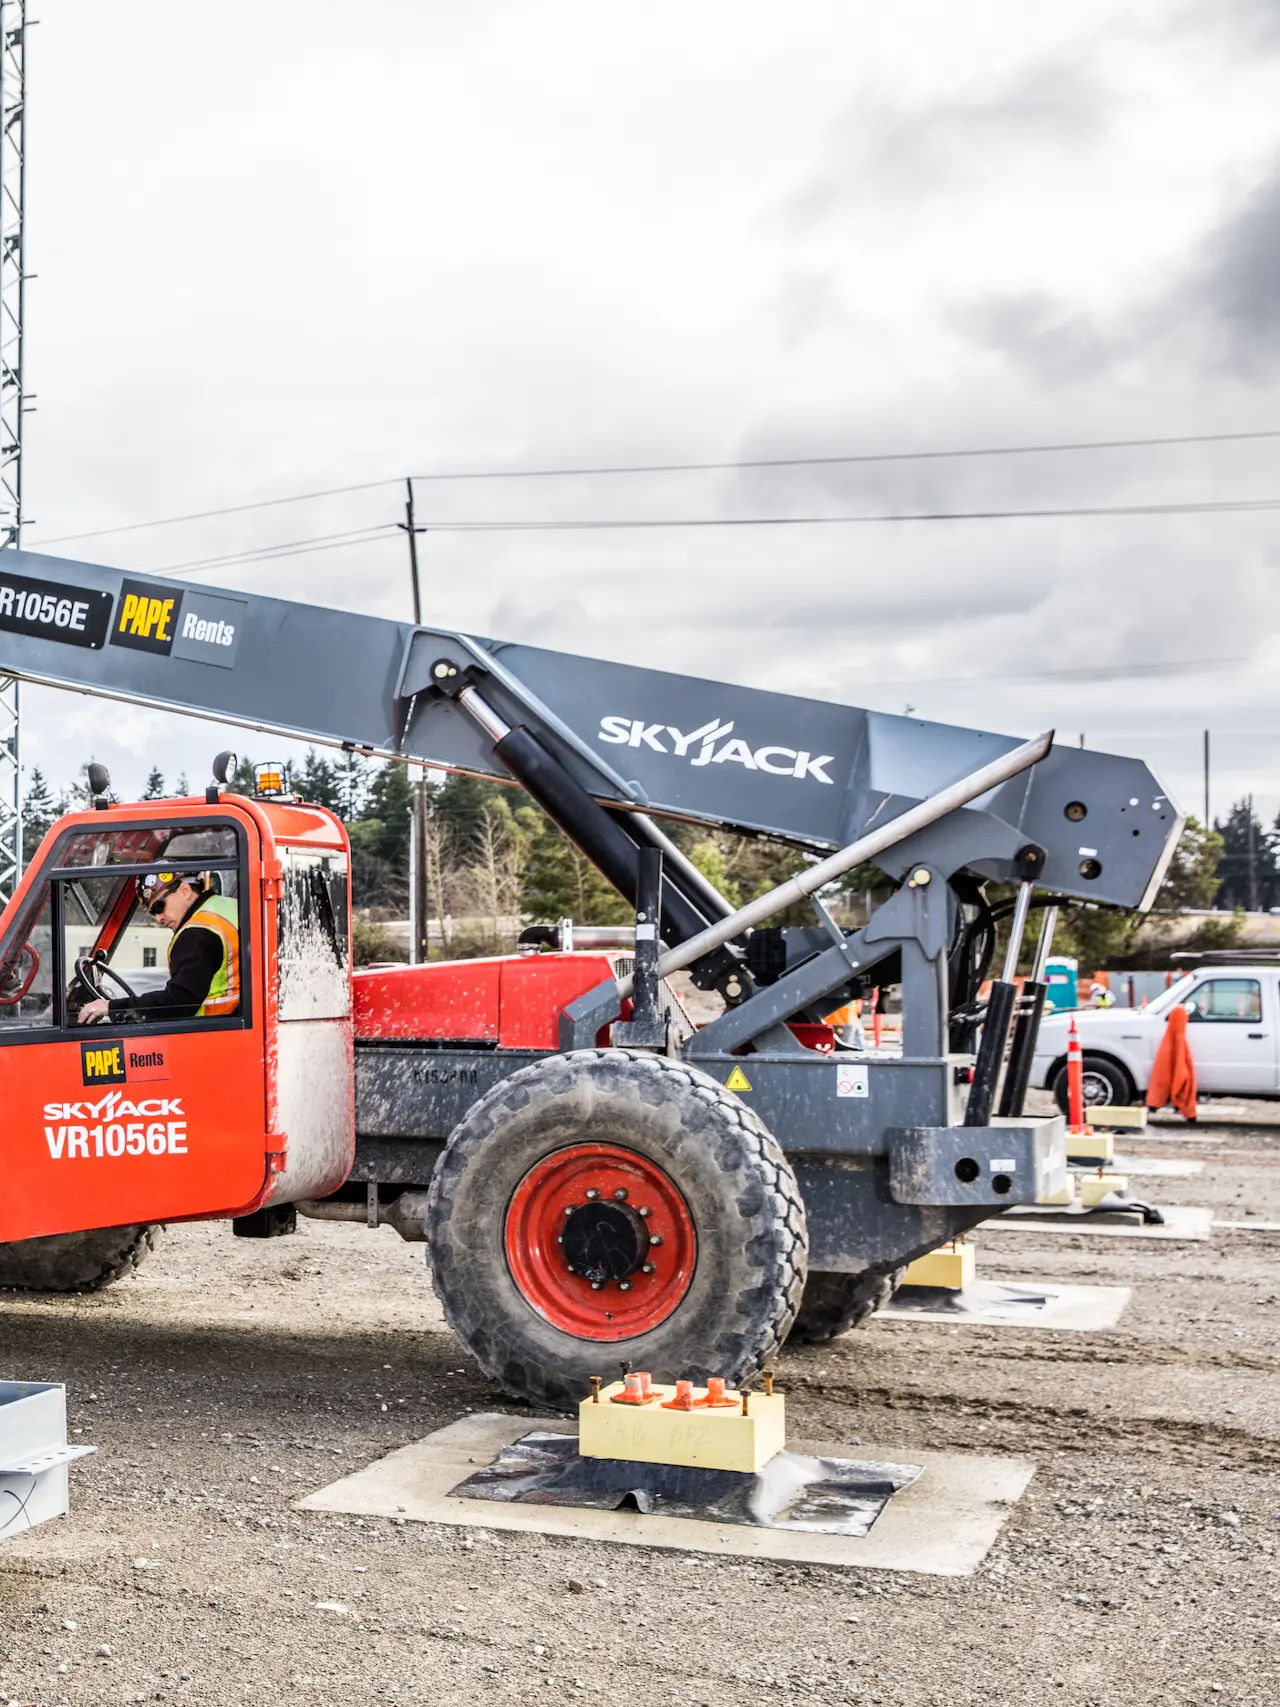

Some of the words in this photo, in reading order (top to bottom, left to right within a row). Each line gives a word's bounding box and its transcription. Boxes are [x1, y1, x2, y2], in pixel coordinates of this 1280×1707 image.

[182, 612, 235, 646] Rents
[597, 715, 835, 785] SKYJACK
[129, 1051, 164, 1068] Rents
[43, 1090, 185, 1122] SKYJACK
[43, 1121, 188, 1159] VR1056E
